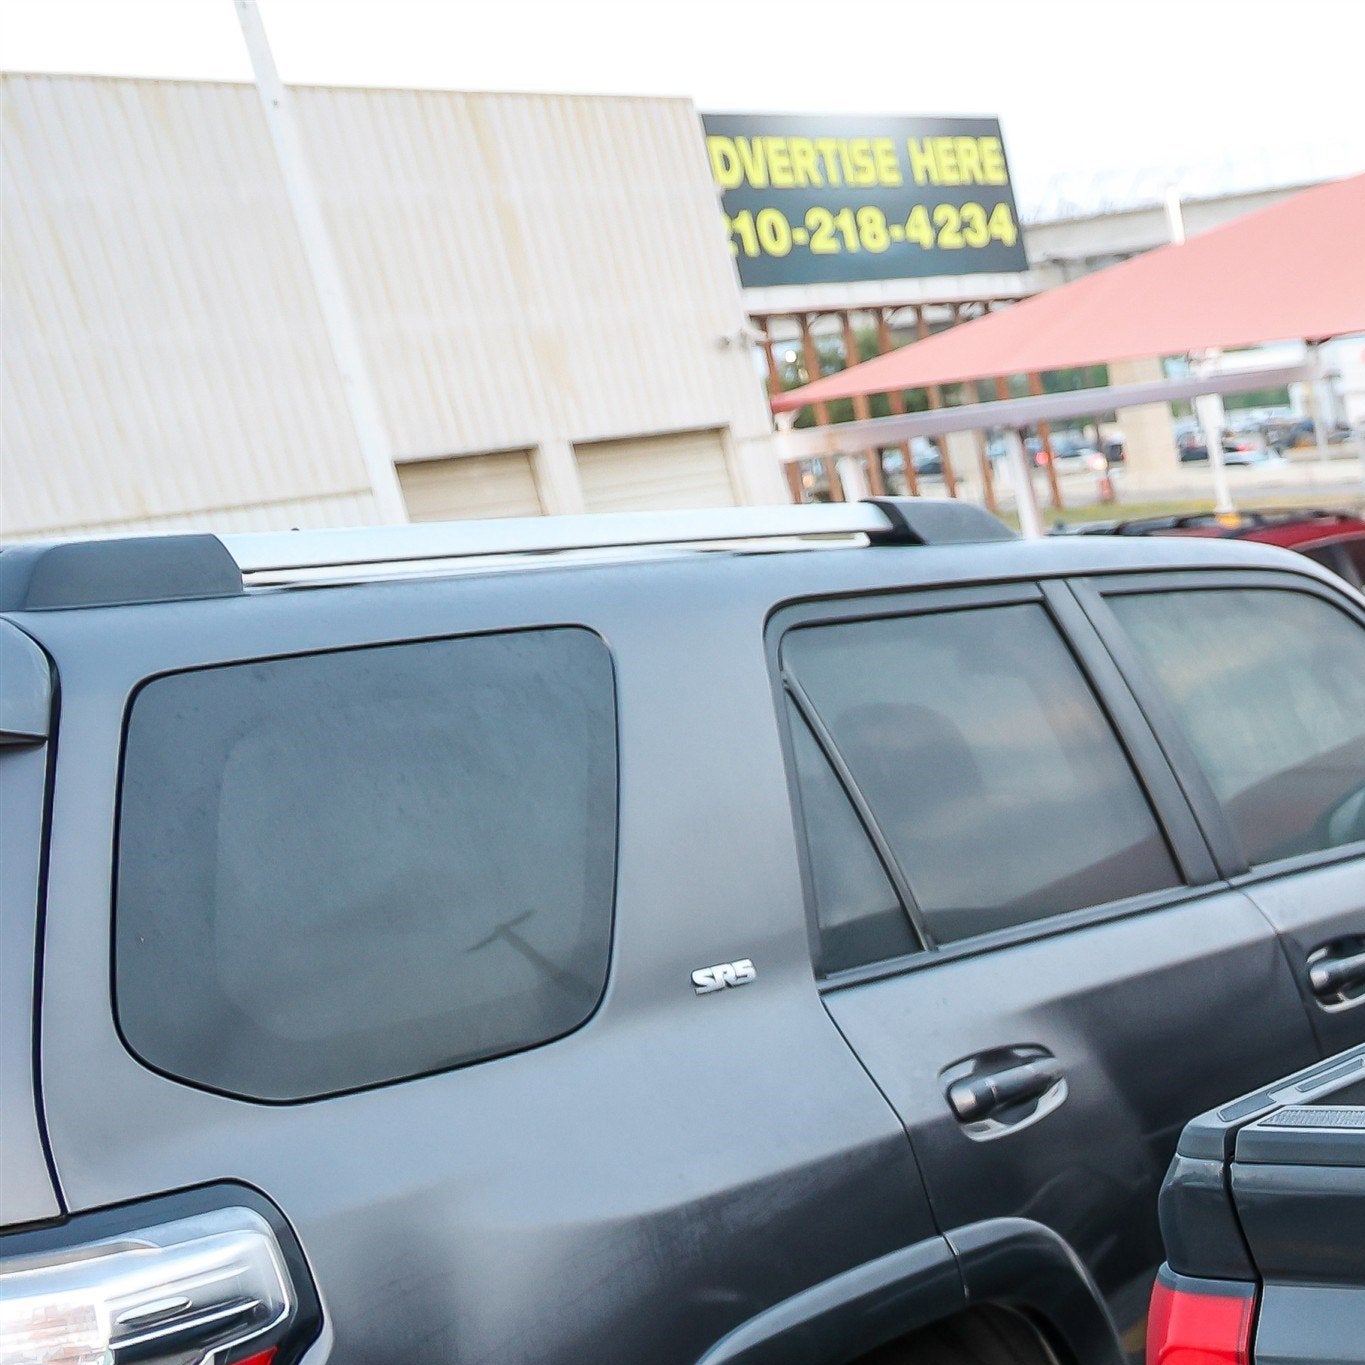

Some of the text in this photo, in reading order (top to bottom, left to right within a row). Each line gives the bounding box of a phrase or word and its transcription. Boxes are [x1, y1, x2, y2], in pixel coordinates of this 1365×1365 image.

[906, 135, 1009, 187] HERE
[721, 202, 1019, 258] 10-218-4234
[690, 957, 757, 996] SR5
